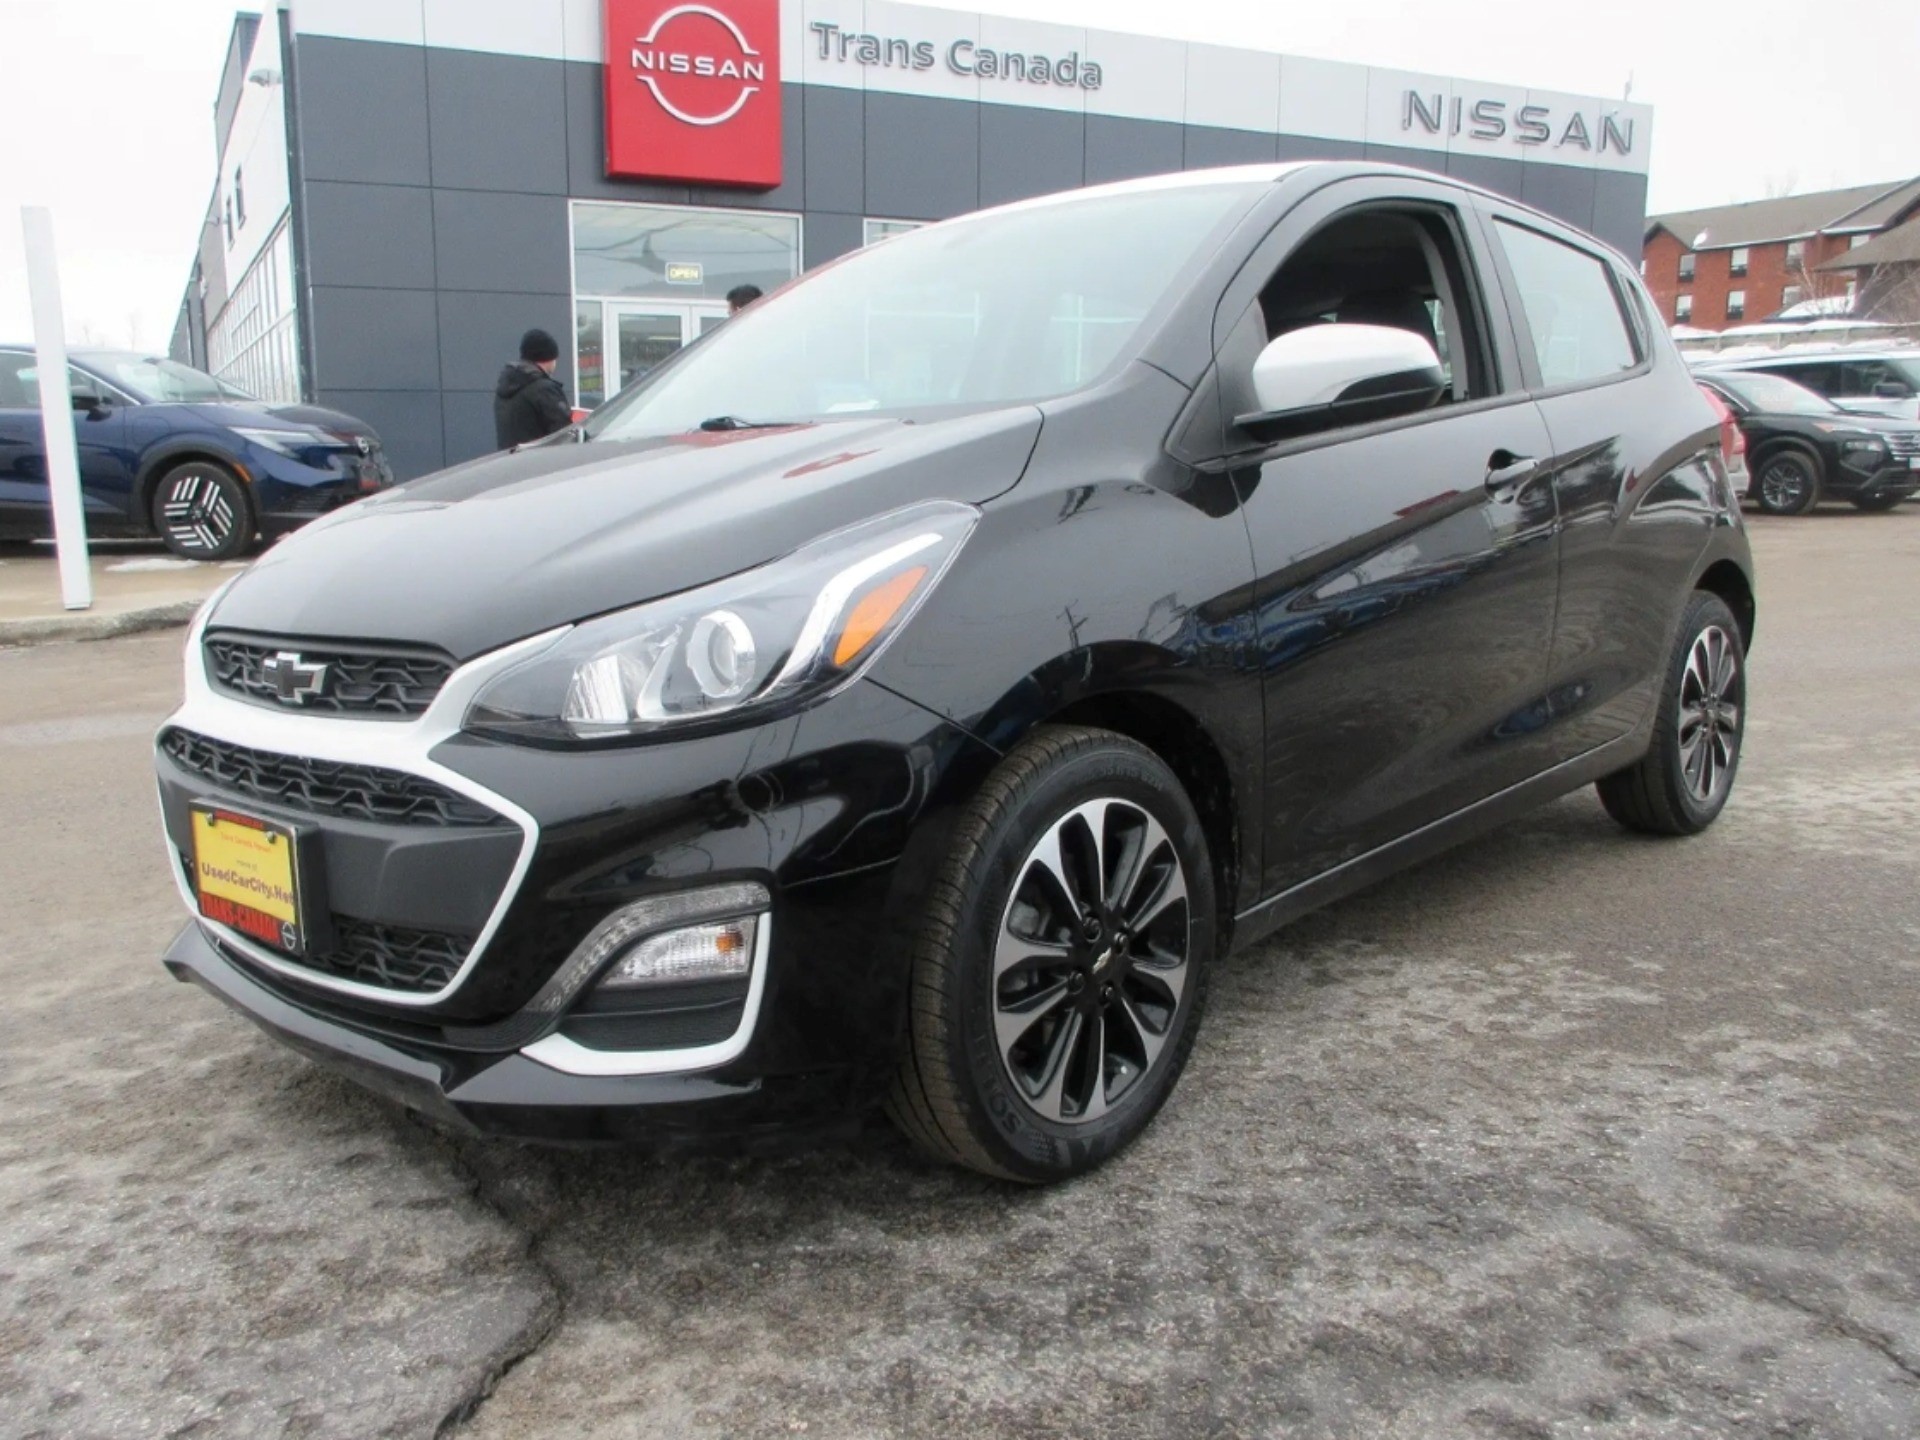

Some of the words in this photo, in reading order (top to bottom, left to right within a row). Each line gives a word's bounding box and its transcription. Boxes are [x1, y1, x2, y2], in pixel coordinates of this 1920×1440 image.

[631, 48, 764, 81] NISSAN
[810, 21, 935, 70] Trans
[946, 39, 1102, 90] Canada
[1402, 89, 1634, 156] NISSAN
[669, 267, 699, 280] OPEN
